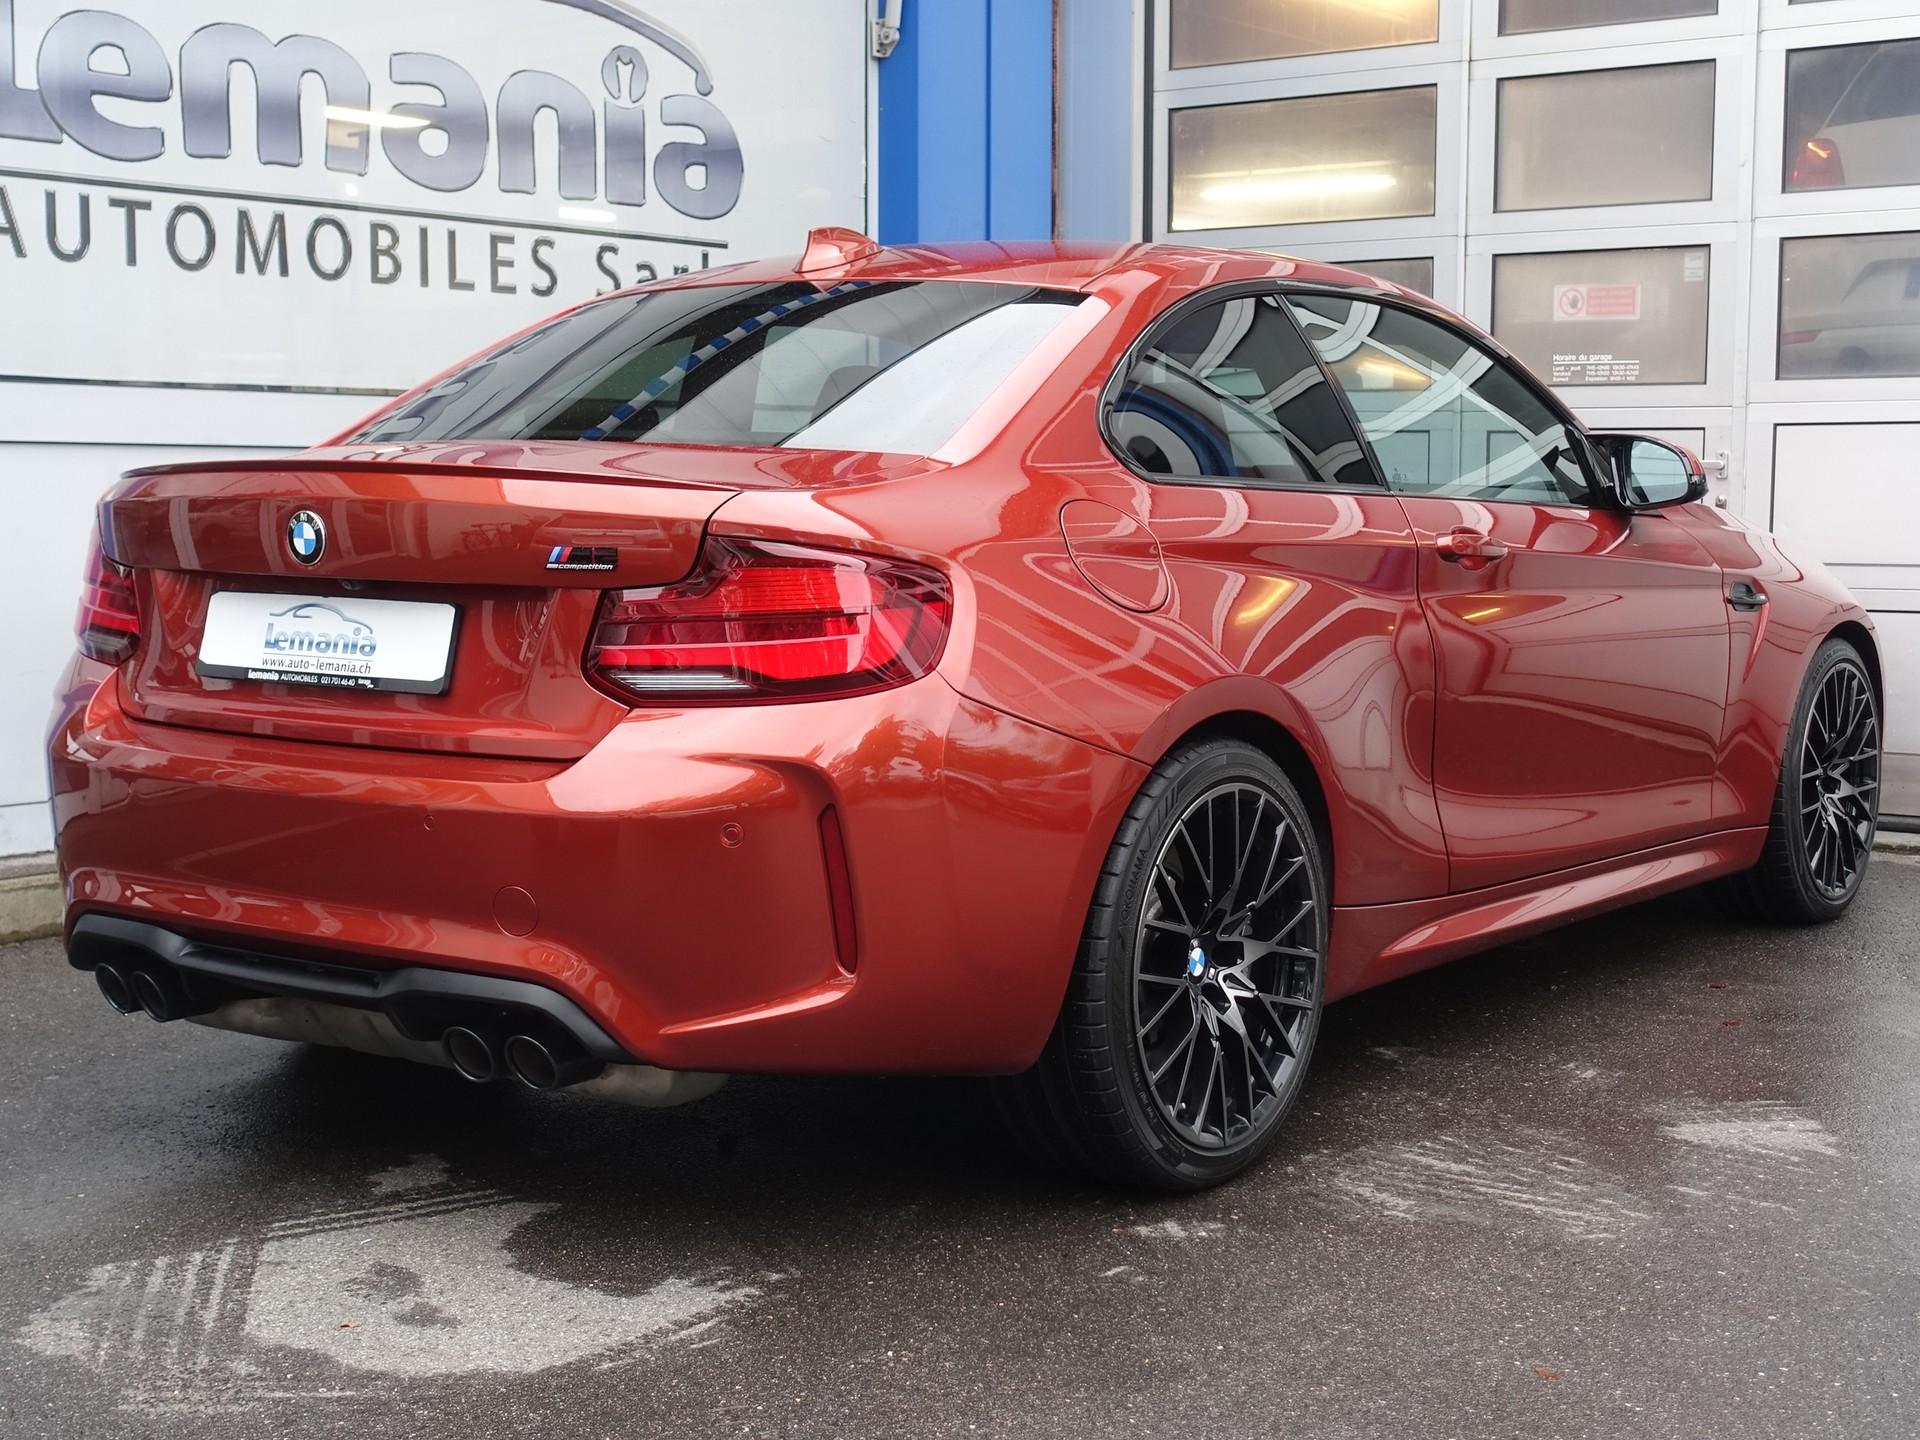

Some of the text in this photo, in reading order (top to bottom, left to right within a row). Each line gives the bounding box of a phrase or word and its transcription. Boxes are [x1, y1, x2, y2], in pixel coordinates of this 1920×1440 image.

[1589, 354, 1613, 362] garage
[264, 622, 377, 657] Lemania
[262, 657, 371, 674] www.auto-lemania.ch
[280, 673, 318, 683] AUTOMOBILES
[1118, 848, 1148, 929] YOKOHAMA
